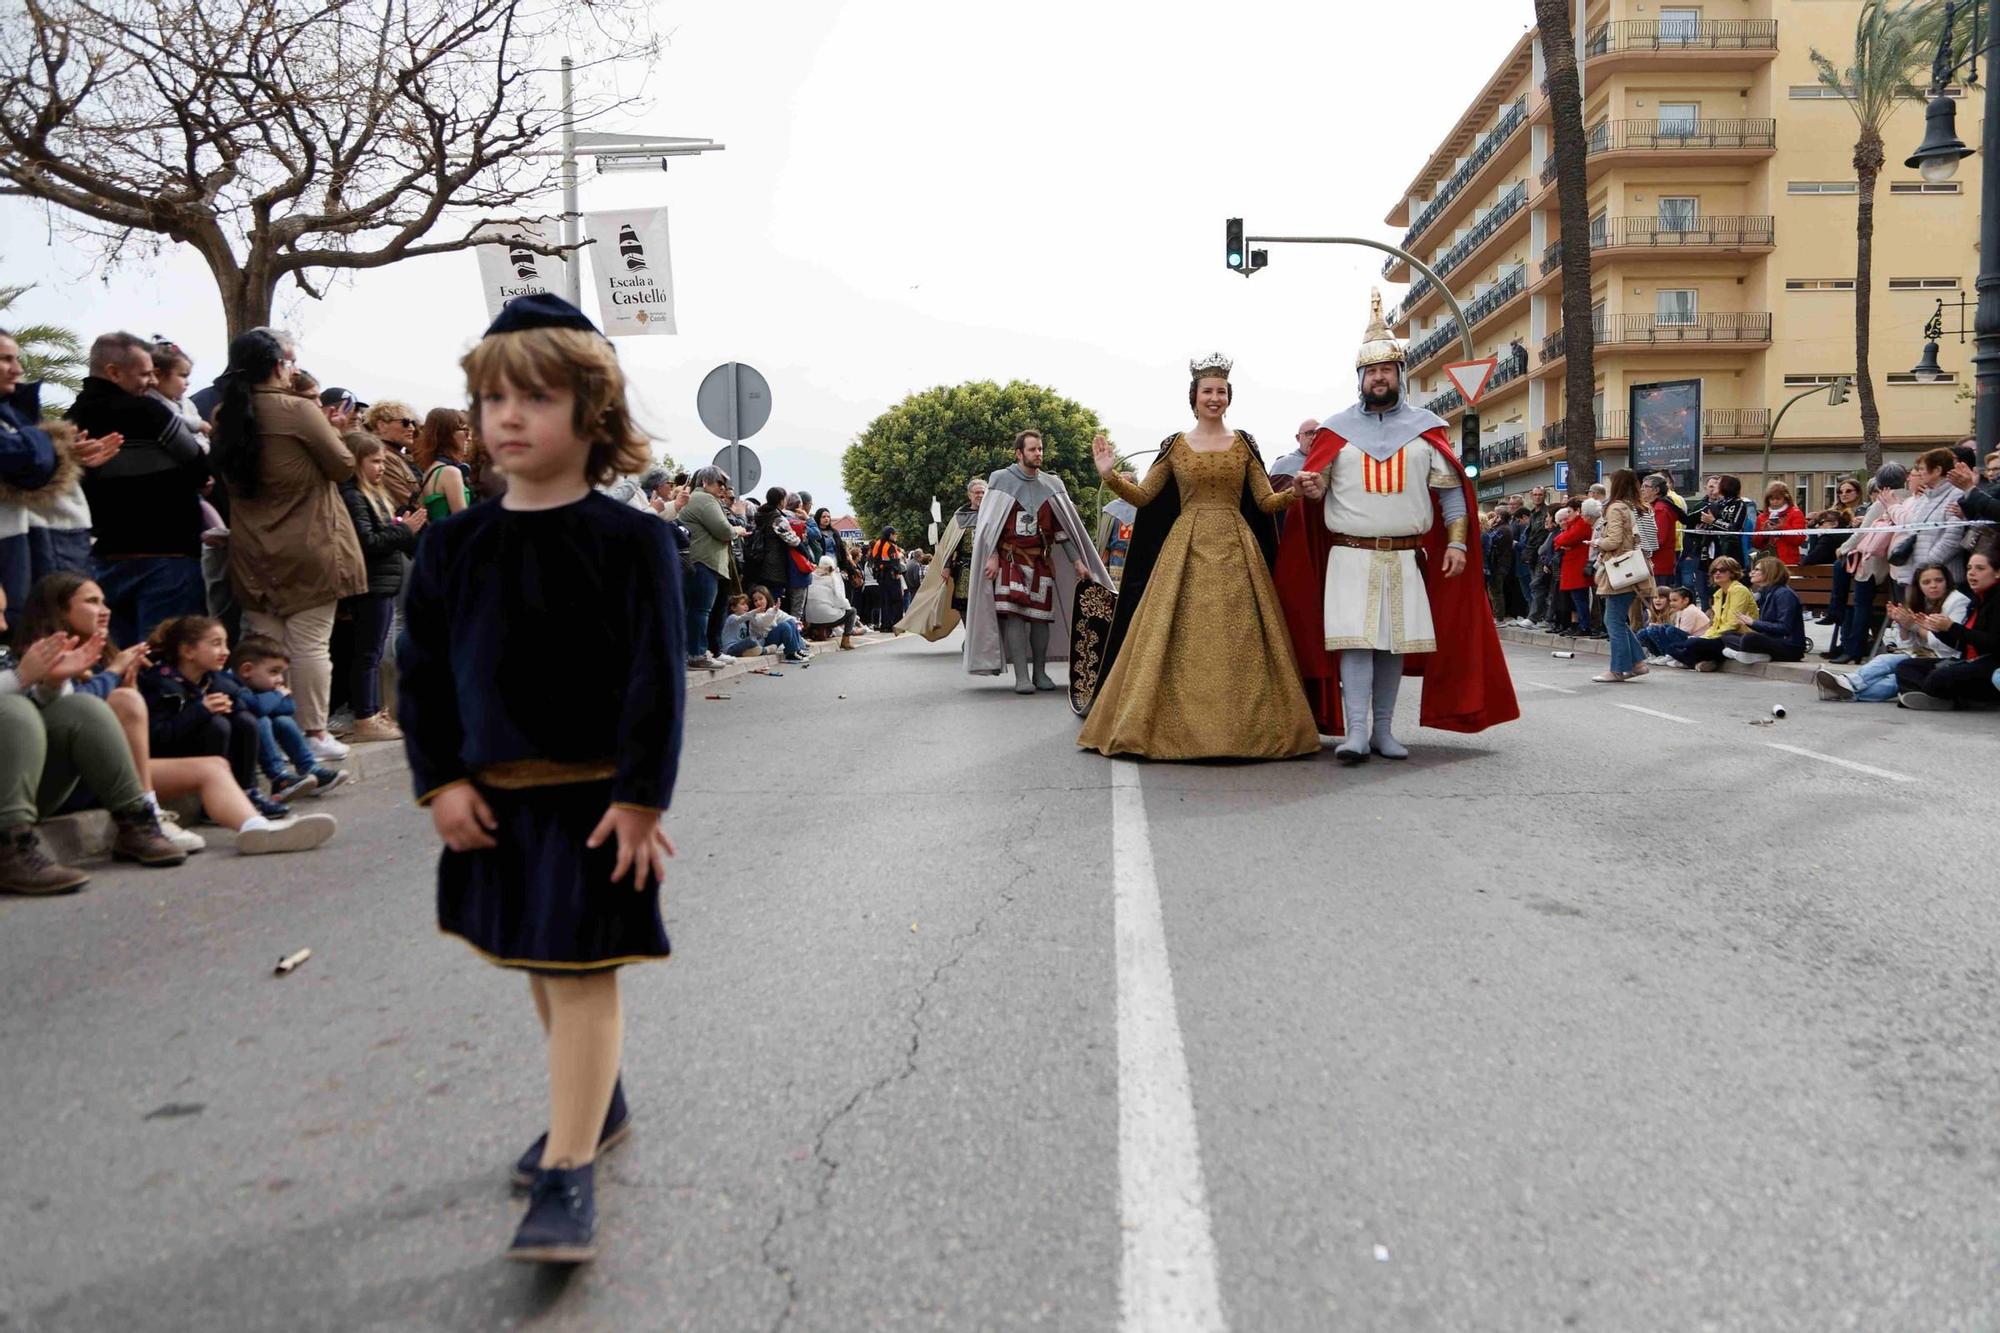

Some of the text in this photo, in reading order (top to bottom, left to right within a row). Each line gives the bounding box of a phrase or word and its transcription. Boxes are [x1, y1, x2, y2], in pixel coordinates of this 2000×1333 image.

[609, 275, 654, 288] Escala a
[500, 284, 546, 297] Escala a
[612, 288, 667, 305] Castelló
